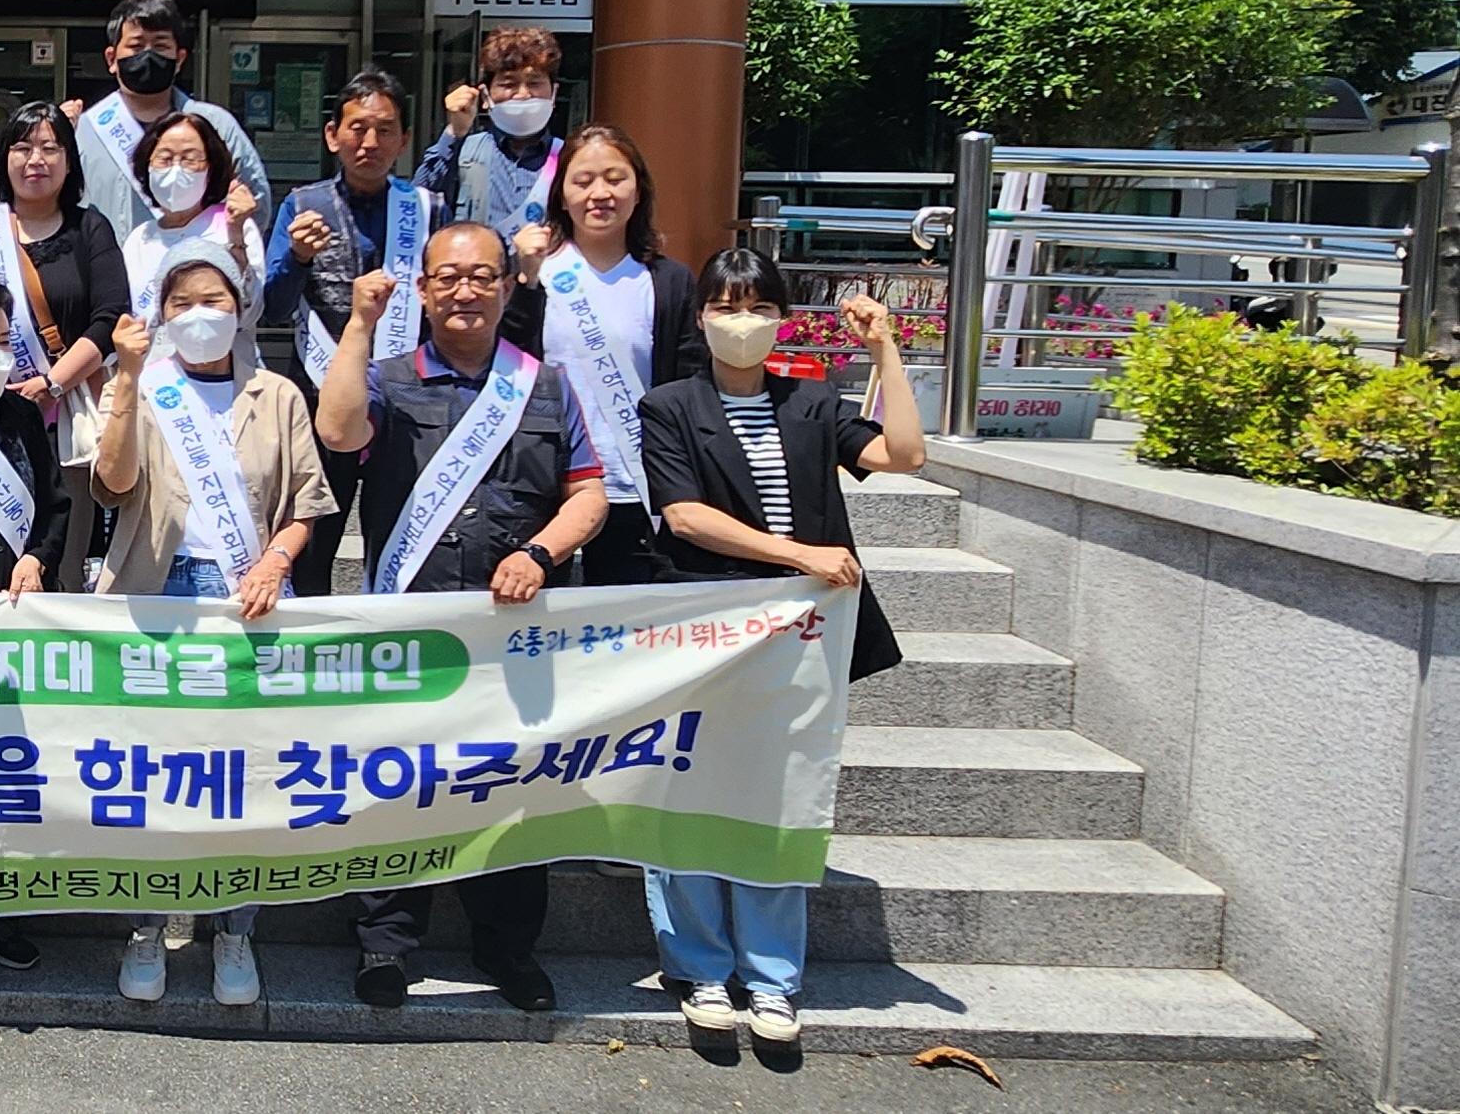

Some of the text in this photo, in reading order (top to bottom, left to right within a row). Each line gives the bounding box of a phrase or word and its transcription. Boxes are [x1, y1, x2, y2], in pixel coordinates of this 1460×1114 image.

[397, 200, 418, 249] 평산동
[569, 297, 606, 352] 평산동
[172, 414, 210, 470] 평산동
[464, 404, 507, 459] 평산동
[506, 624, 573, 658] 소통과
[578, 623, 626, 653] 공정
[634, 623, 684, 649] 다시
[690, 621, 740, 650] 뛰는
[119, 641, 229, 697] 발굴
[254, 638, 422, 695] 캠페인
[74, 738, 246, 829] 함께
[275, 711, 702, 829] 찾아주세요!
